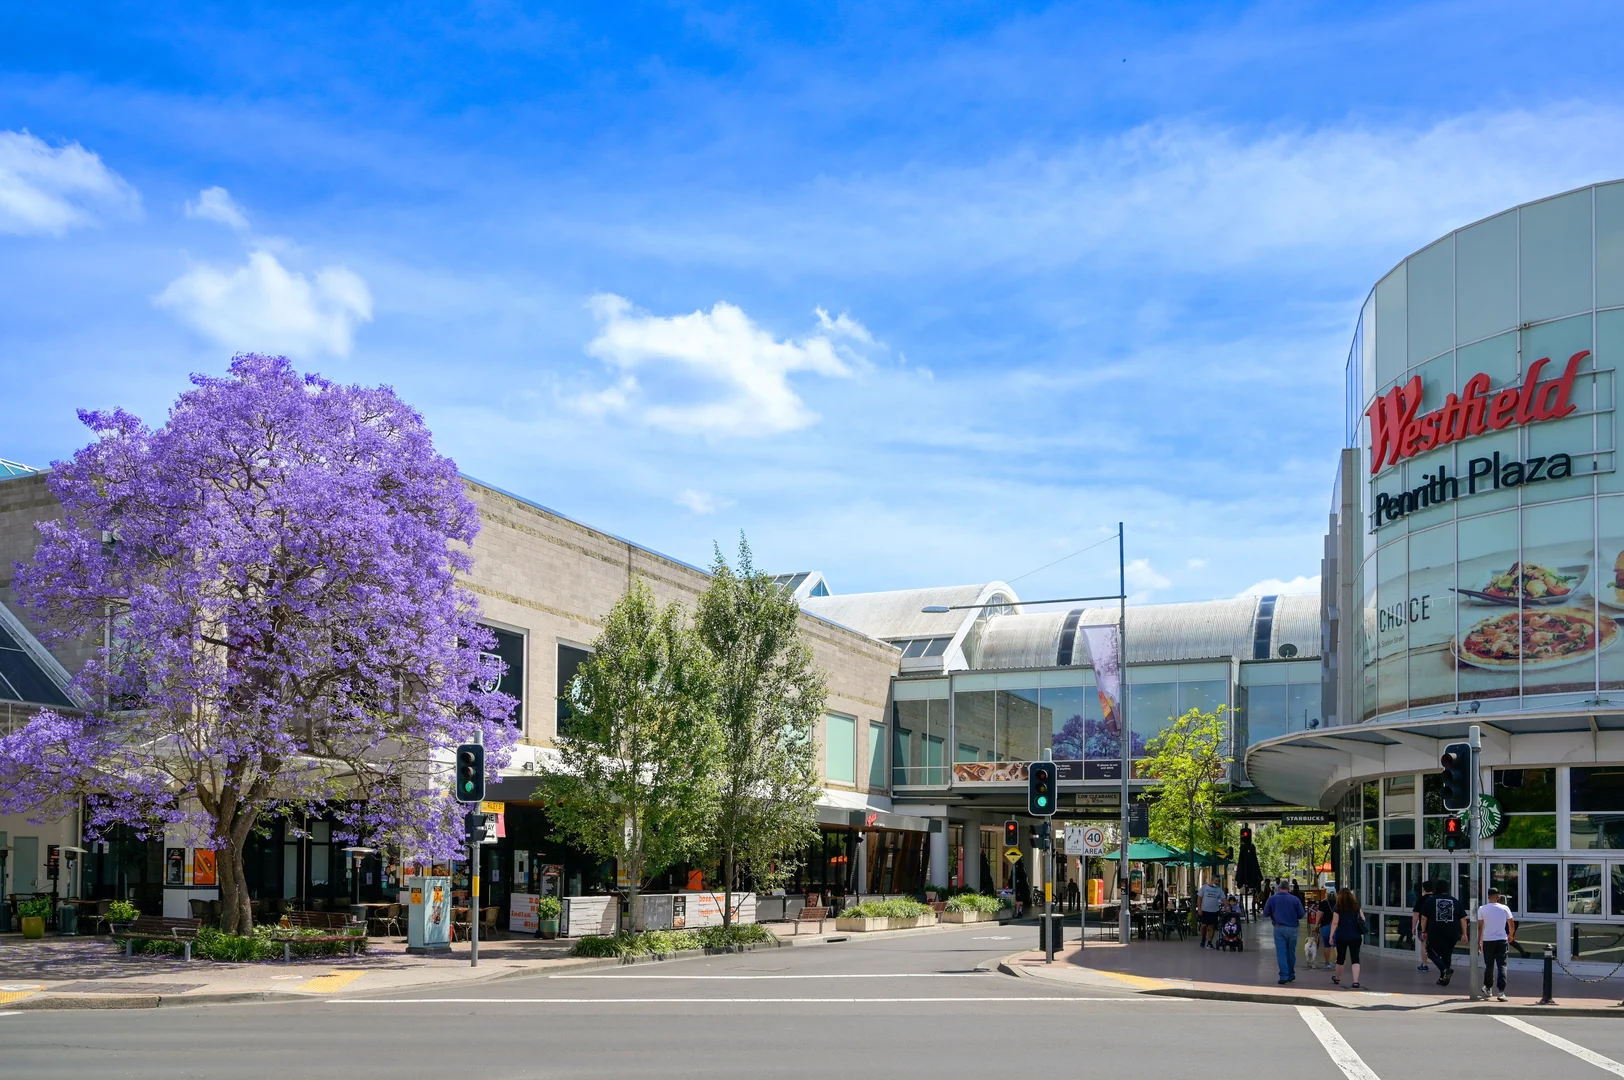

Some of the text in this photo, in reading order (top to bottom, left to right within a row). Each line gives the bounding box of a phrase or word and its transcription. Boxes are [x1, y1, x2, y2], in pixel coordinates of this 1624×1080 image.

[1365, 350, 1591, 474] Westfield
[1376, 451, 1572, 526] Penrith Plaza
[1380, 595, 1430, 632] CHOICE
[1394, 635, 1404, 643] Street
[1087, 833, 1101, 842] 40
